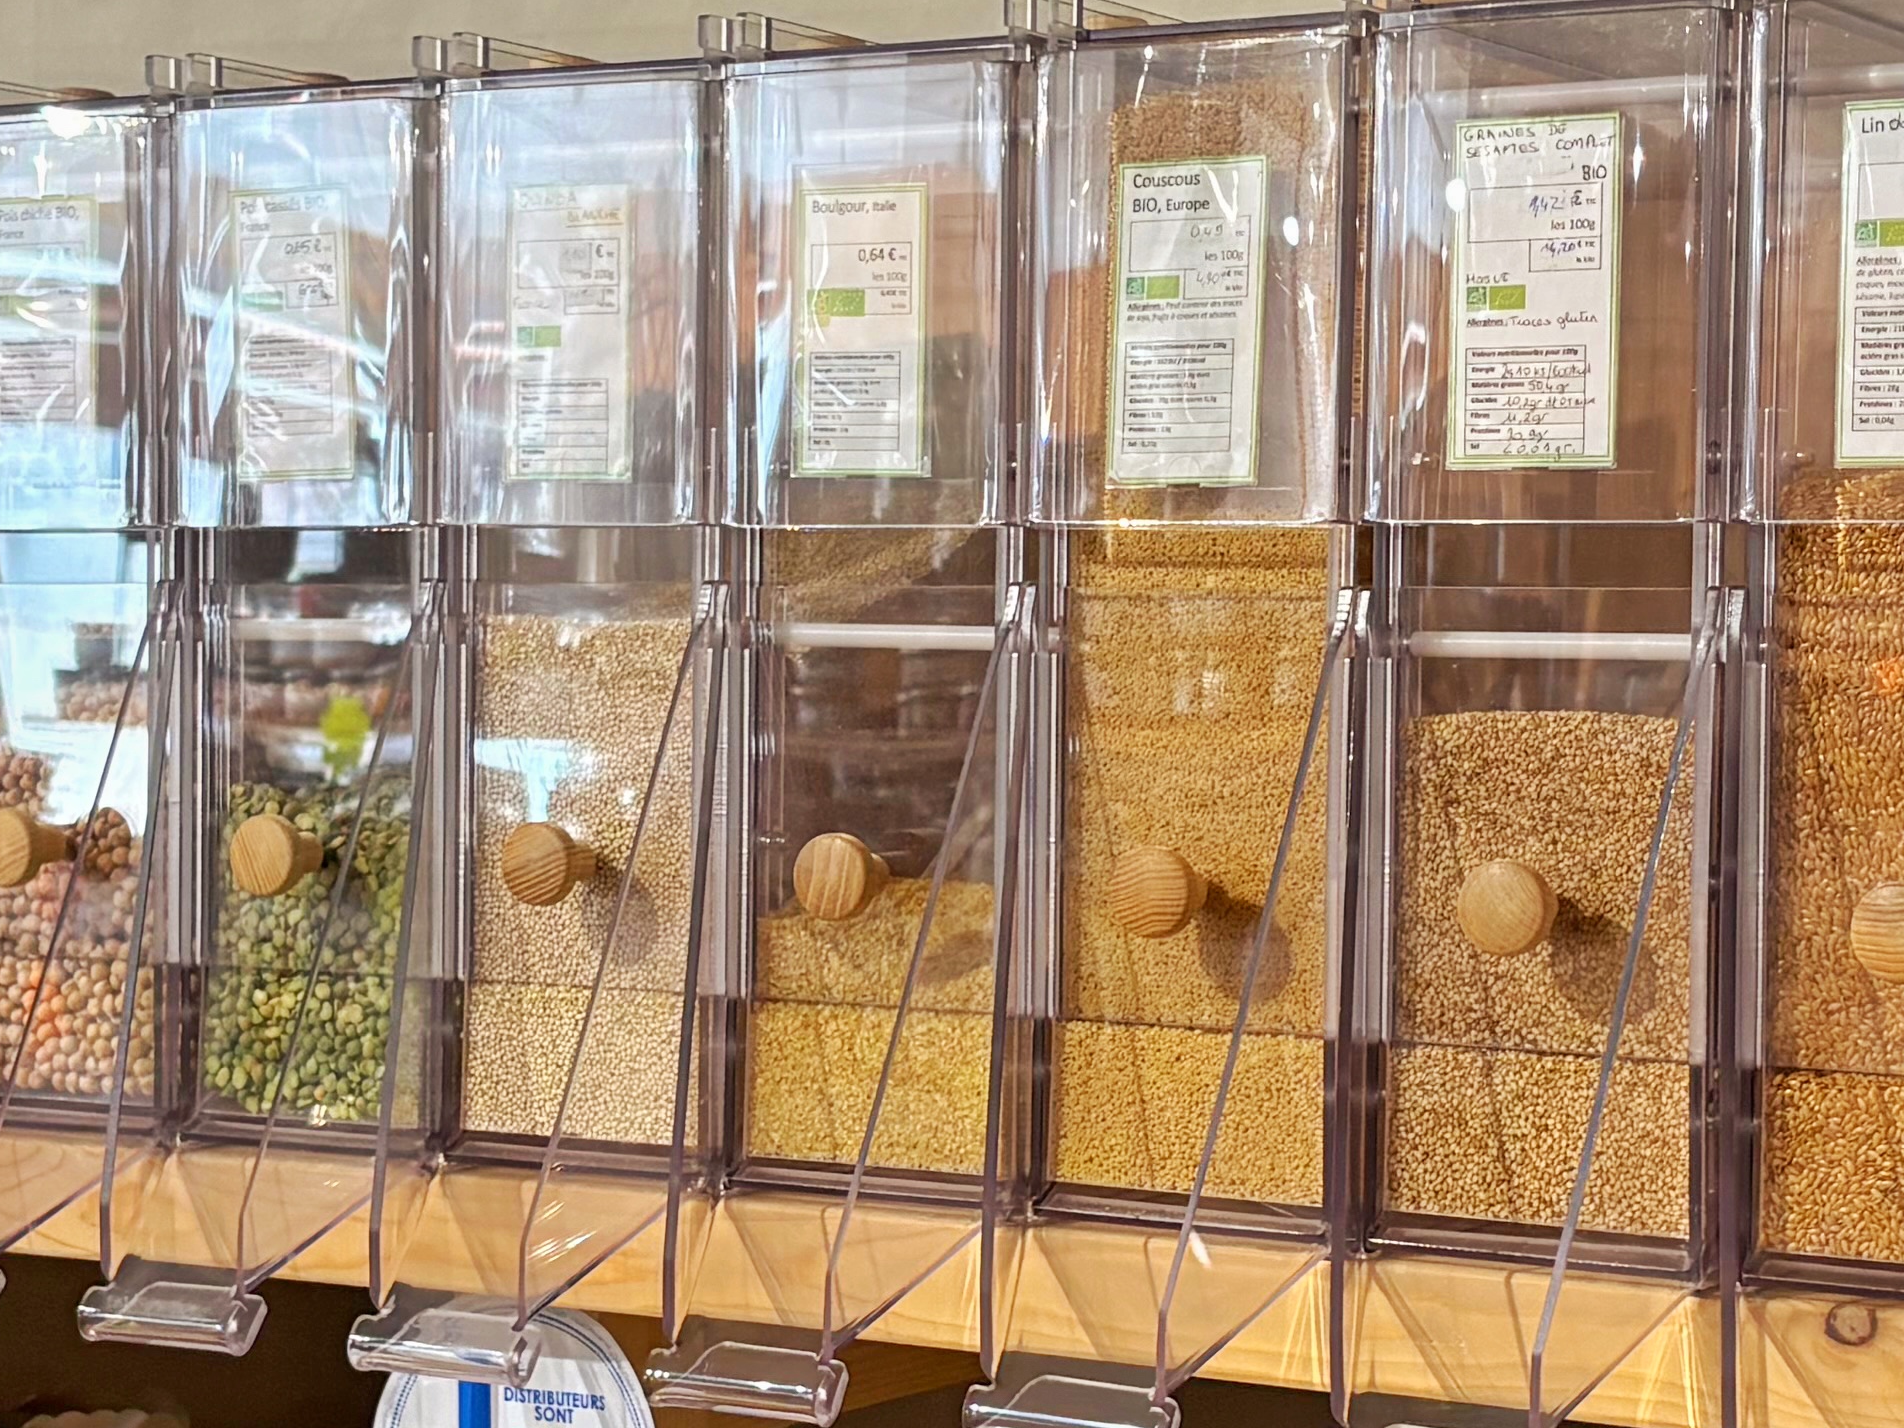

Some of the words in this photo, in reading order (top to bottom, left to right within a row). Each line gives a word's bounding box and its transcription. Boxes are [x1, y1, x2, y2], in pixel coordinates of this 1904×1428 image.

[1862, 118, 1884, 133] Lin
[1133, 173, 1200, 188] Couscous
[1582, 165, 1607, 181] BIO
[812, 199, 869, 216] Boulgour,
[1133, 198, 1161, 213] BIO,
[1166, 199, 1210, 212] Europe
[1570, 219, 1595, 230] 100g
[858, 248, 884, 264] 0,64
[1221, 250, 1244, 261] 100g
[503, 1386, 606, 1411] DISTRIBUTEURS
[535, 1407, 574, 1424] SONT
